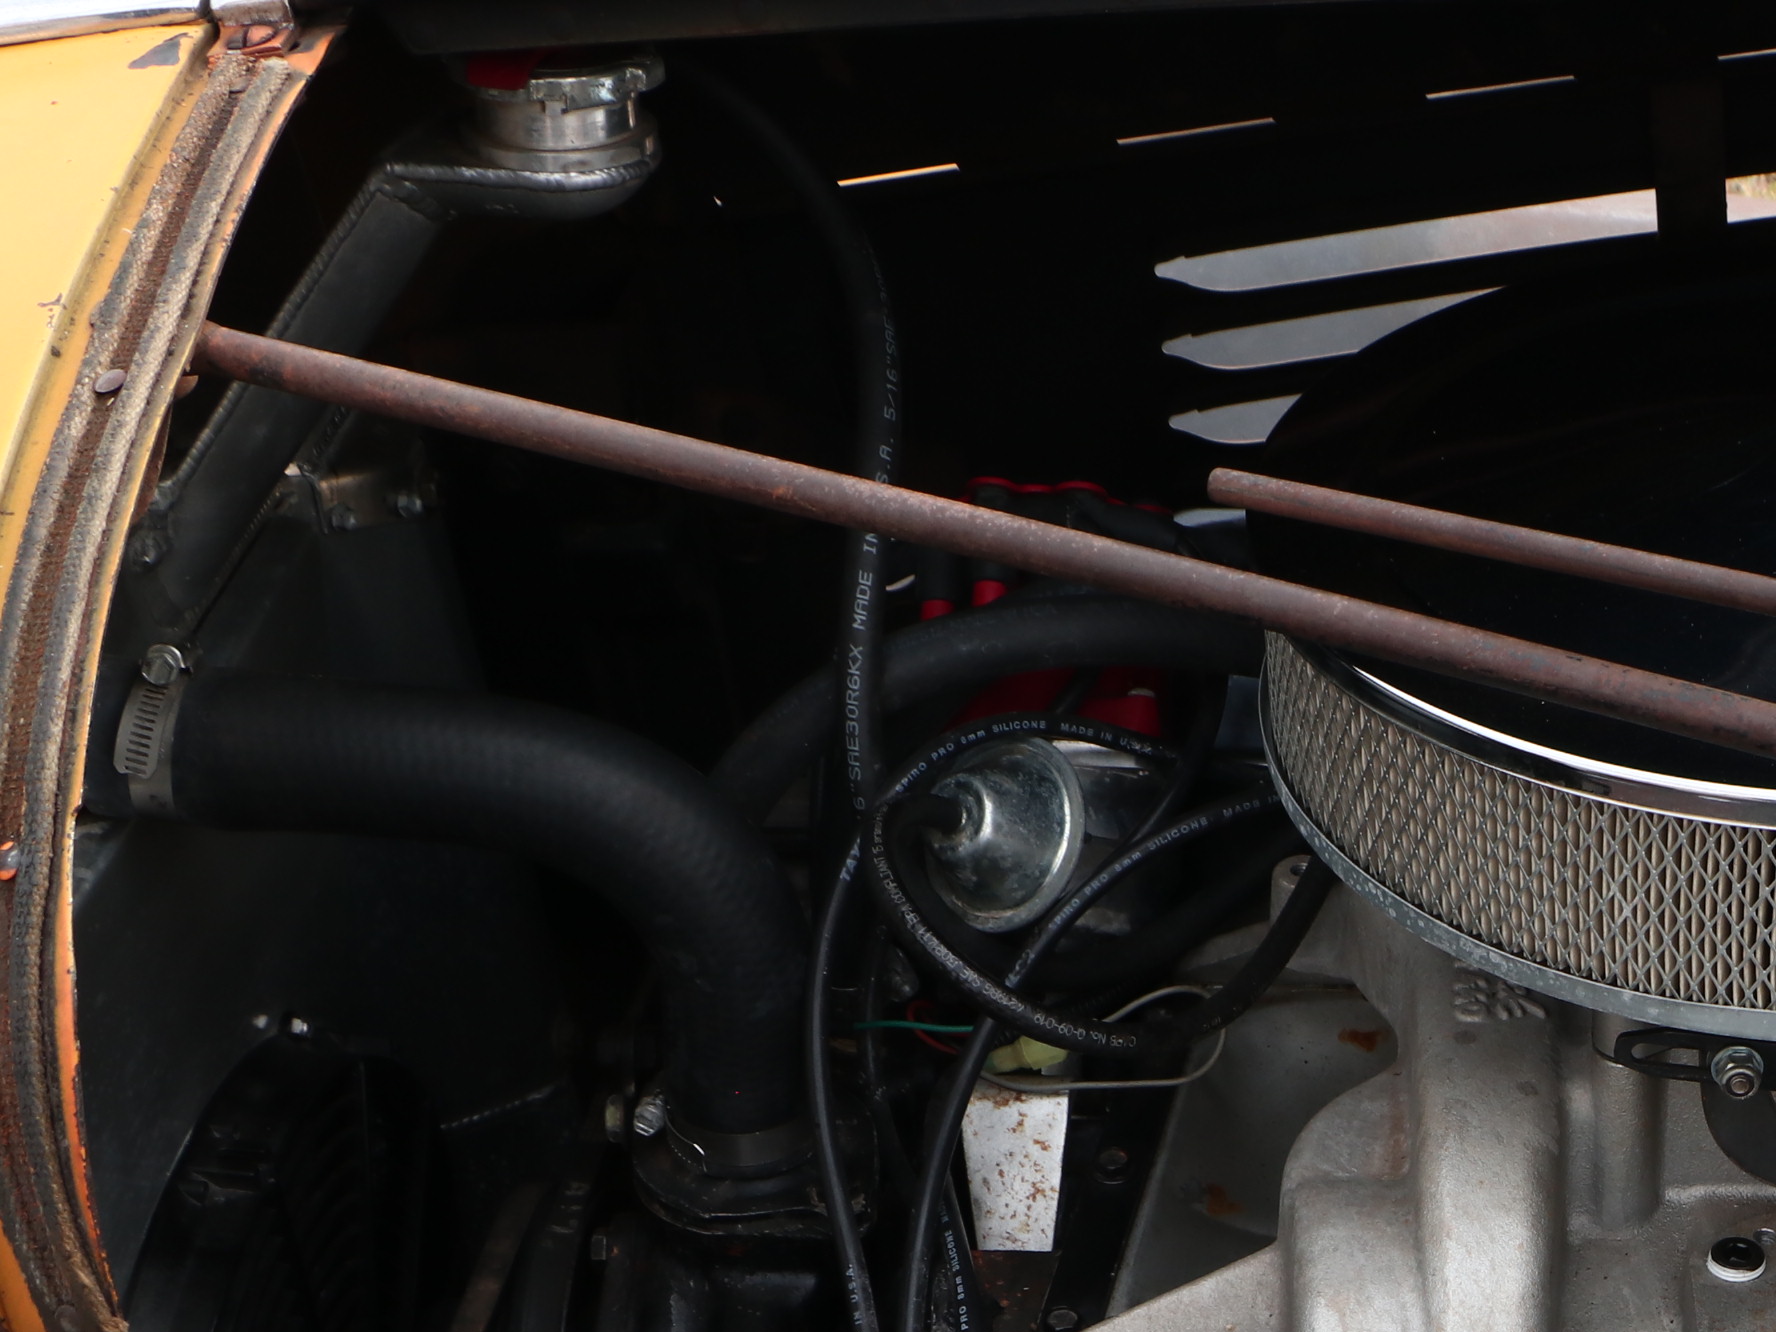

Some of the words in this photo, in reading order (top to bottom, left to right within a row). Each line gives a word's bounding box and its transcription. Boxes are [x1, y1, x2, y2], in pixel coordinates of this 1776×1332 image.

[851, 570, 874, 631] MADE
[895, 762, 928, 794] SPIRO
[931, 742, 955, 761] PRO
[992, 719, 1048, 734] SILICONE
[1060, 721, 1095, 738] MADE
[1100, 730, 1114, 743] IN
[1083, 873, 1109, 897] PRO
[1148, 816, 1210, 851] SILICONE
[1222, 799, 1262, 818] MADE
[959, 966, 981, 988] SAE
[1089, 1030, 1107, 1046] No.
[944, 1229, 961, 1272] SILICONE
[846, 1263, 860, 1304] U.S.A.
[955, 1275, 967, 1301] 8mm
[853, 1310, 863, 1326] IN
[958, 1305, 970, 1332] PRO
